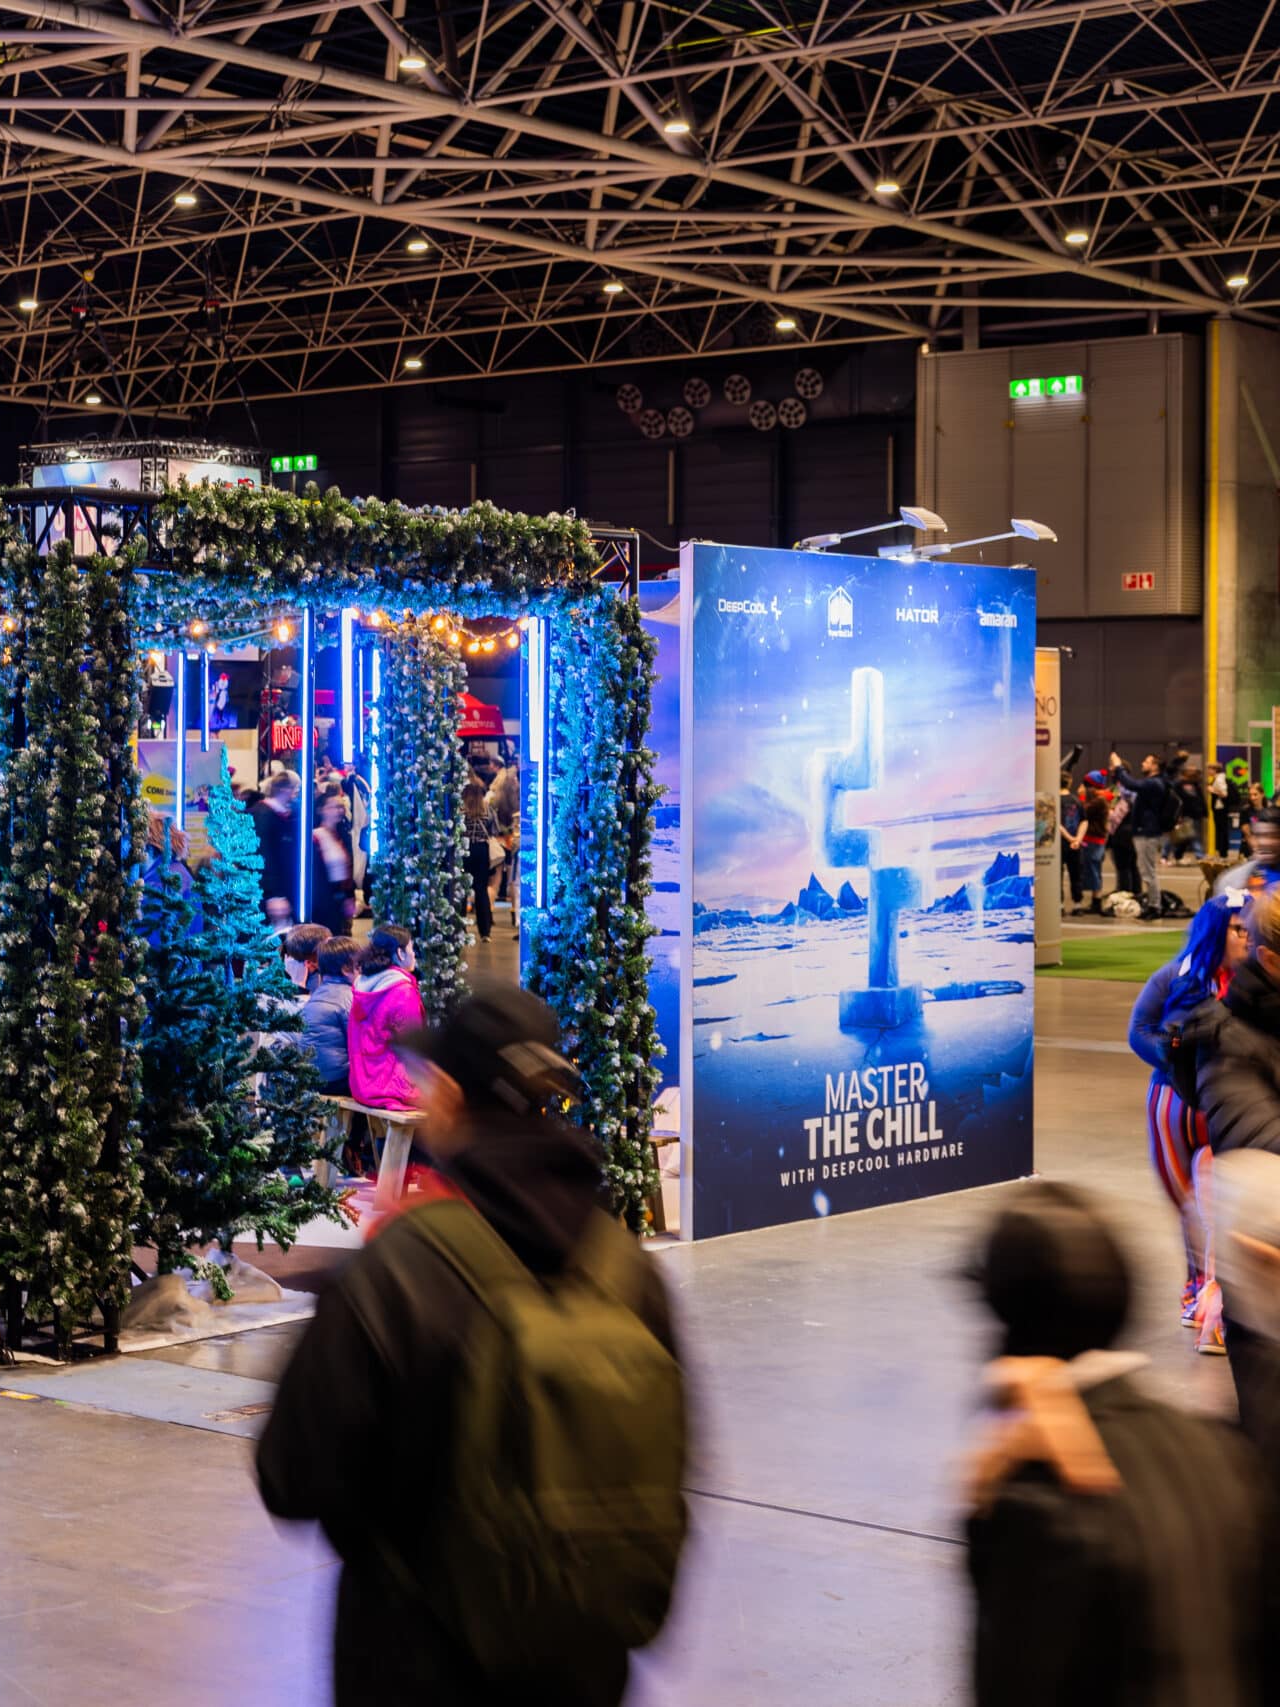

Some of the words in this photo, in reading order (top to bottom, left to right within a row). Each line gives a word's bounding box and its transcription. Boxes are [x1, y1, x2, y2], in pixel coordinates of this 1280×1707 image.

[895, 607, 939, 624] HATOR
[978, 611, 1018, 629] amaran
[825, 1062, 926, 1114] MASTER
[803, 1112, 860, 1161] THE
[866, 1101, 944, 1151] CHILL
[780, 1167, 815, 1187] WITH
[822, 1155, 891, 1179] DEEPCOOL
[897, 1142, 964, 1166] HARDWARE
